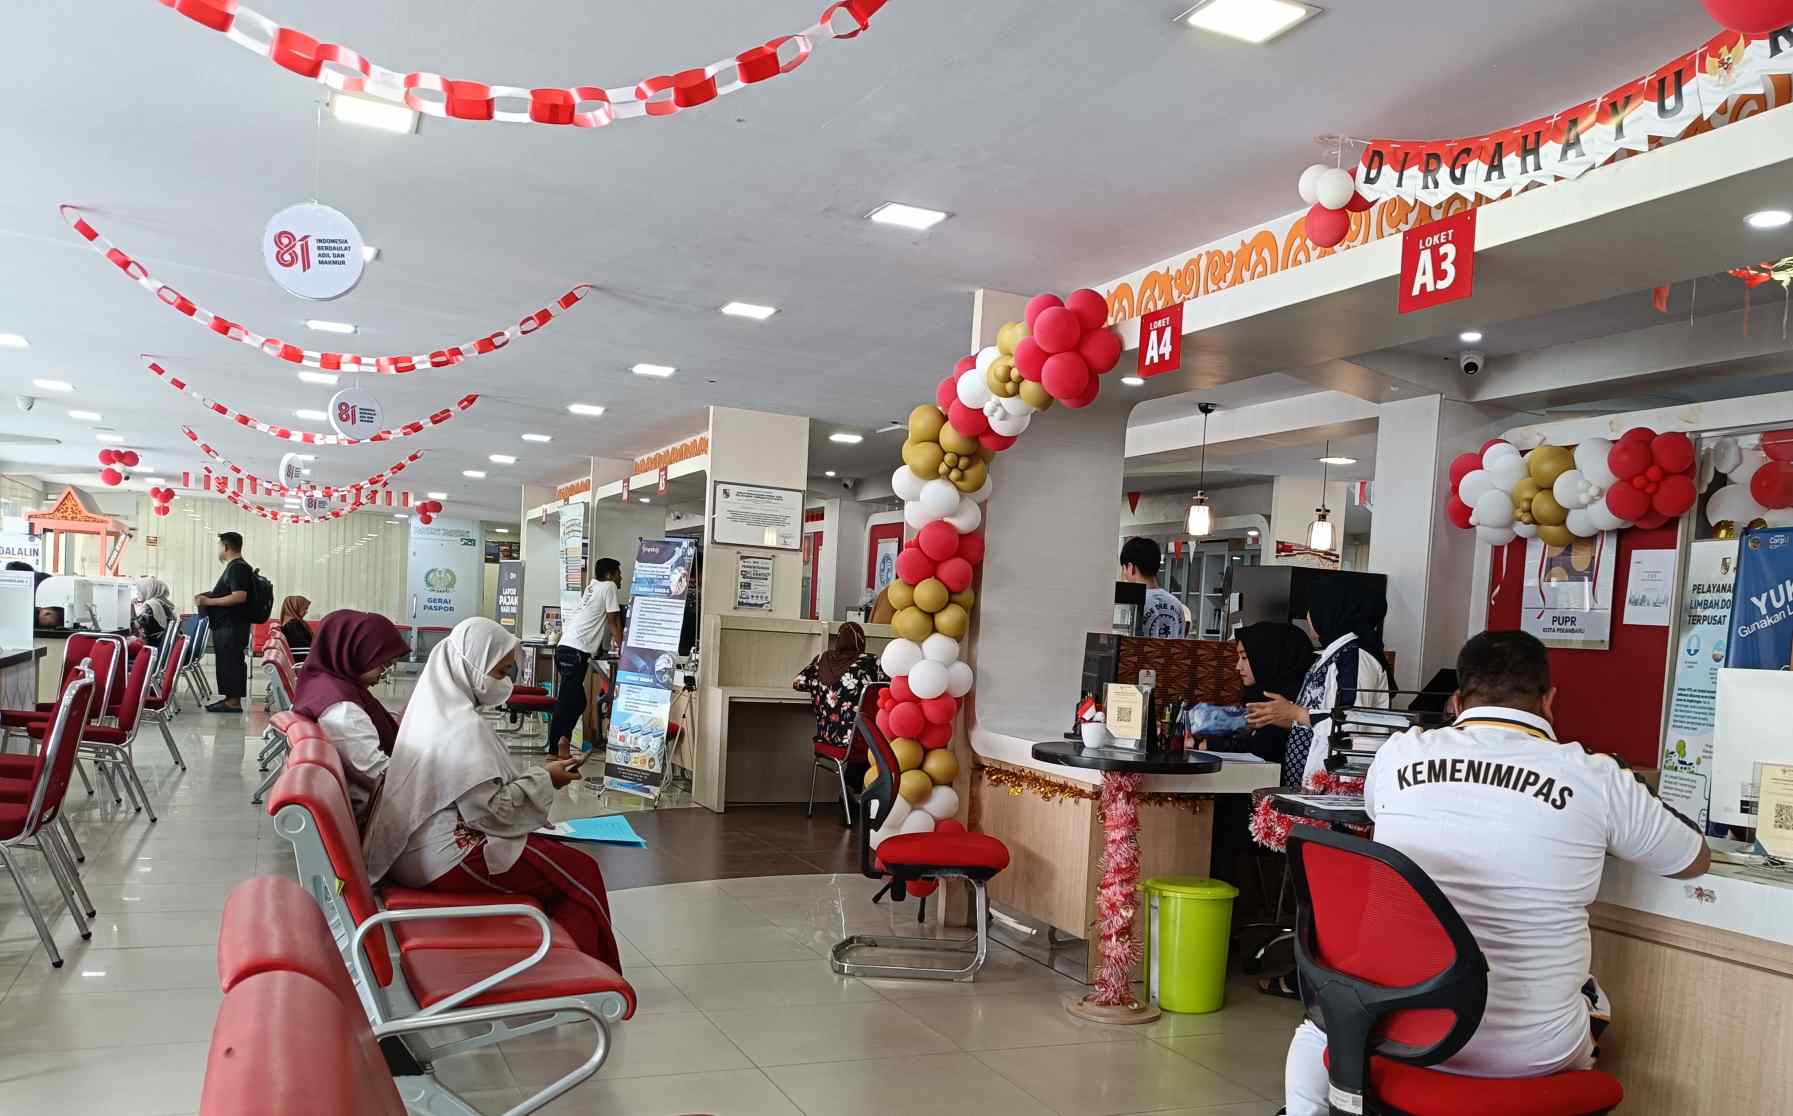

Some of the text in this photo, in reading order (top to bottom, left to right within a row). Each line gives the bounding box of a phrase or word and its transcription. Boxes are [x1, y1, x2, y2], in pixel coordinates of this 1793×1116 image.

[1362, 68, 1685, 191] DIRGAHAYU
[1419, 229, 1455, 250] LOKET
[273, 230, 312, 272] 81
[1411, 244, 1457, 297] A3
[1149, 317, 1170, 330] LOKET
[1145, 326, 1172, 366] A4
[338, 402, 357, 425] 81
[1692, 583, 1733, 594] PELAYANA
[423, 604, 455, 612] PASPOR
[1689, 600, 1720, 610] LIMBAH
[1551, 615, 1577, 626] PUPR
[1687, 614, 1728, 625] TERPUSAT
[1738, 610, 1786, 638] Gunakan
[1397, 758, 1574, 811] KEMENIMIPAS
